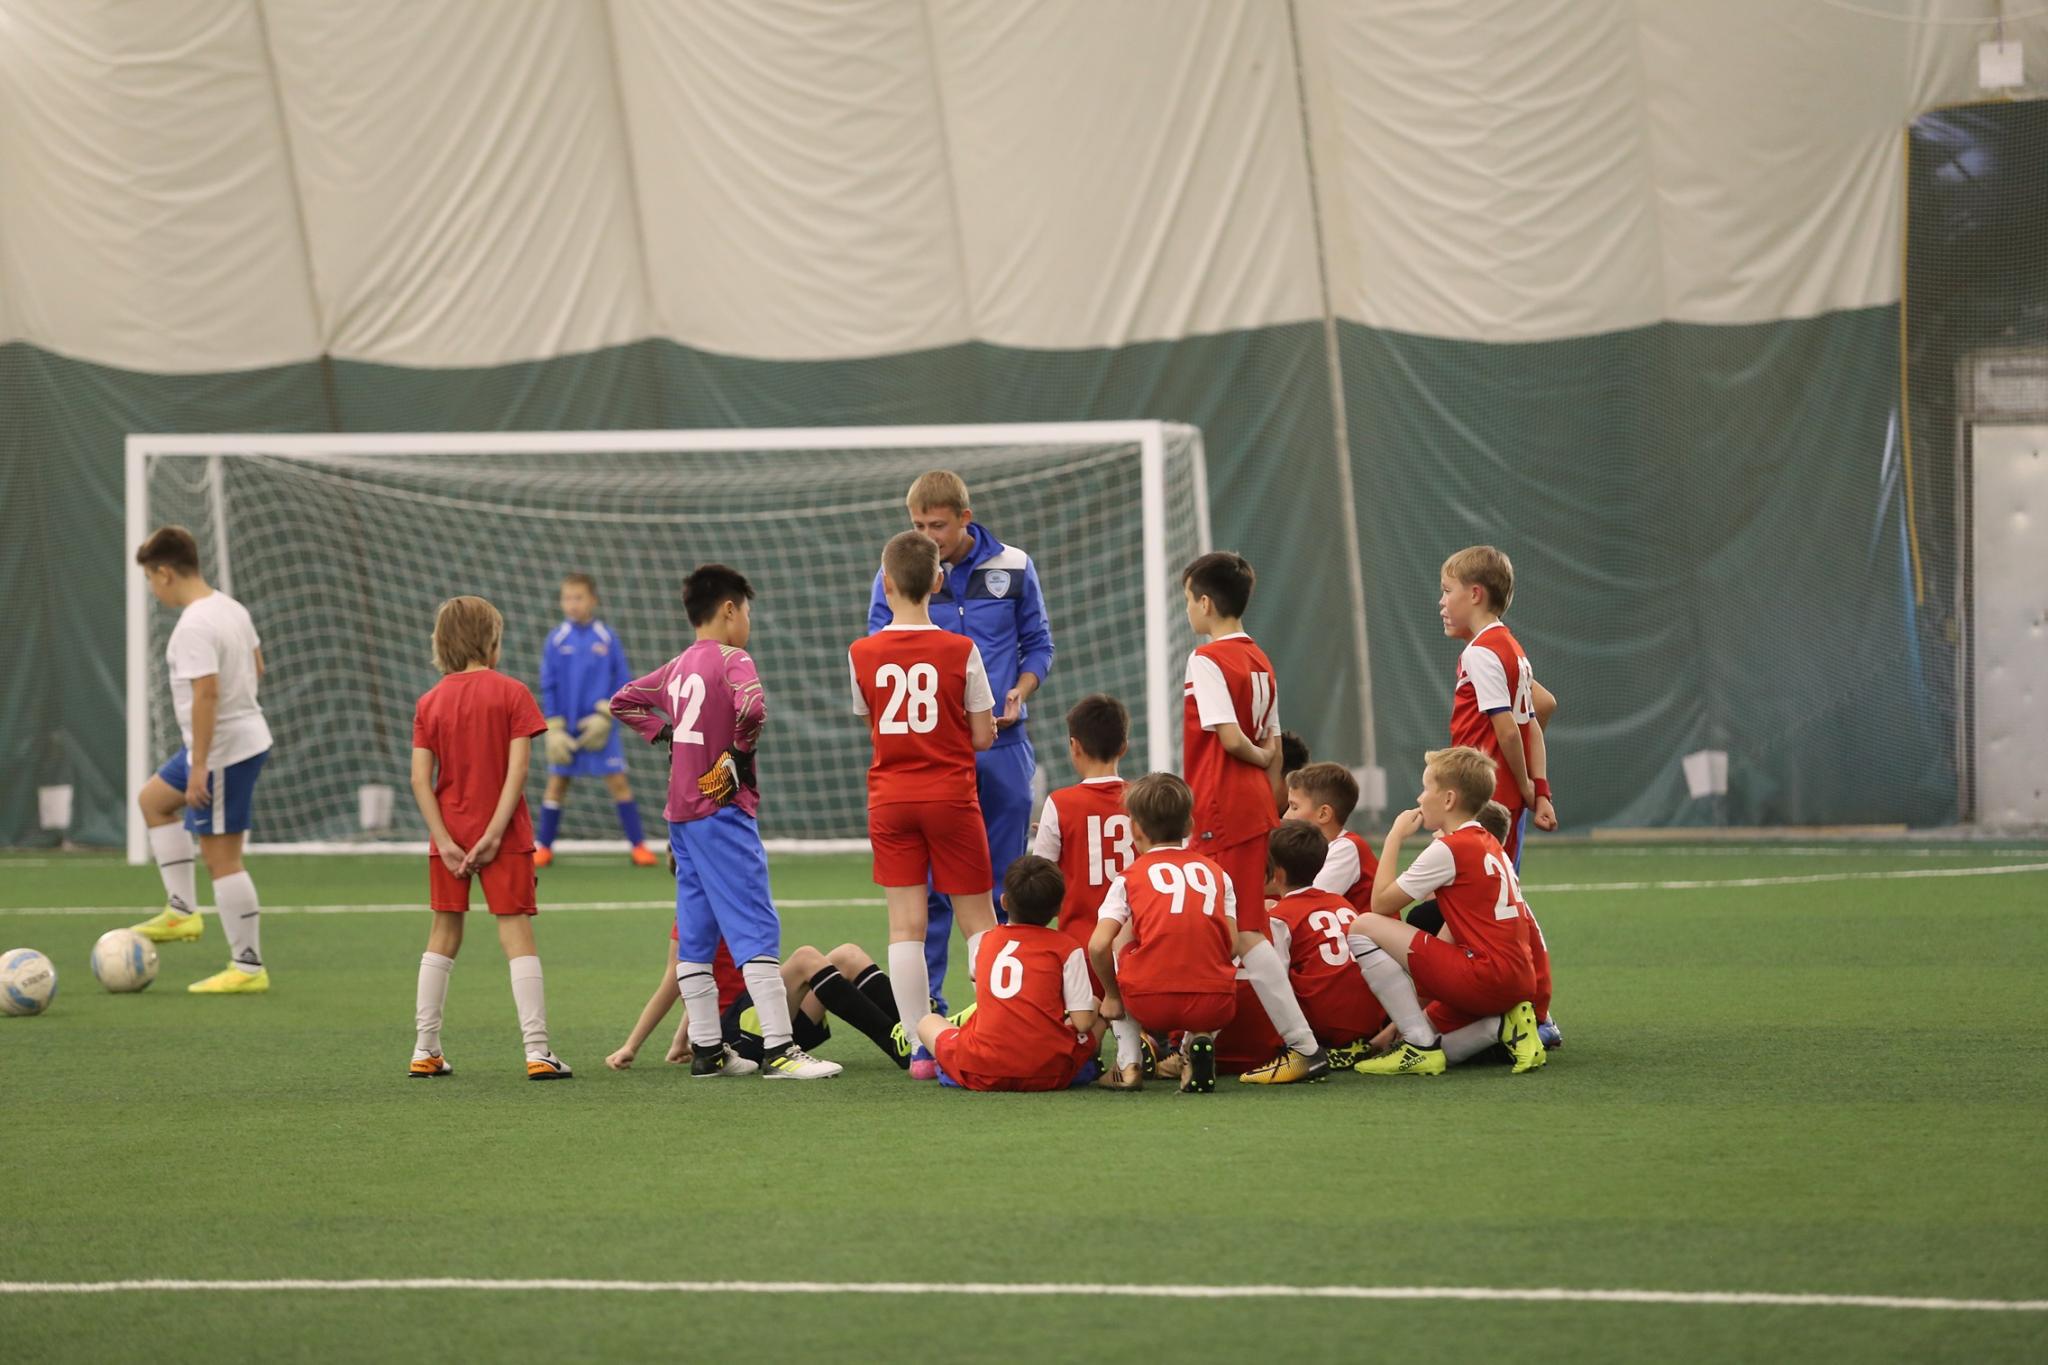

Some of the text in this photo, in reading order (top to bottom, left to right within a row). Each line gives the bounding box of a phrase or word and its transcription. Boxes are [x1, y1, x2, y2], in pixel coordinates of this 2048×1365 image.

[667, 673, 706, 745] 12
[876, 663, 938, 734] 28
[1087, 814, 1135, 884] 13
[1147, 862, 1218, 916] 99
[990, 940, 1024, 999] 6
[1398, 1055, 1427, 1071] adidas
